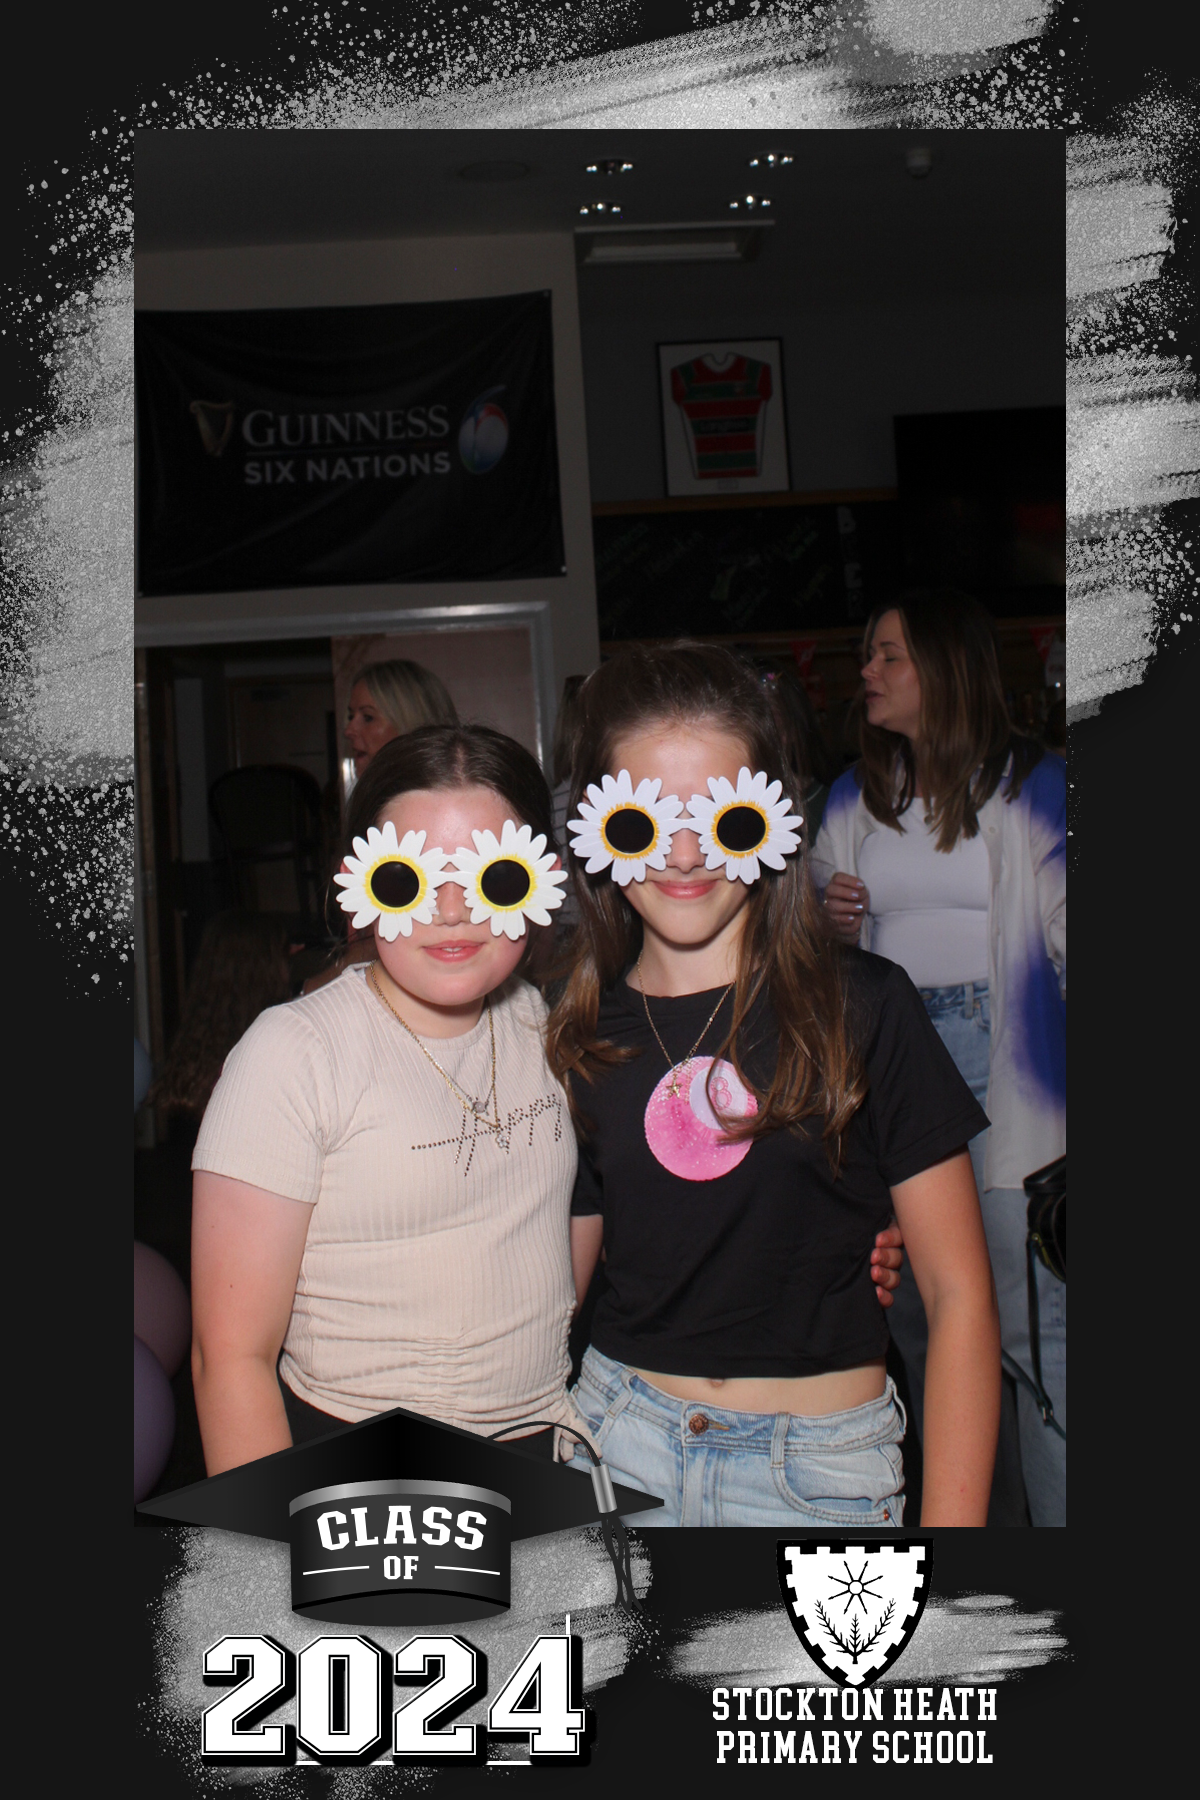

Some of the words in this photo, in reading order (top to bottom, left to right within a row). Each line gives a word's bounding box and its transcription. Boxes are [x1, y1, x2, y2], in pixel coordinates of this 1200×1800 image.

[241, 404, 449, 448] GUINNESS
[244, 461, 296, 485] SIX
[307, 450, 450, 482] NATIONS
